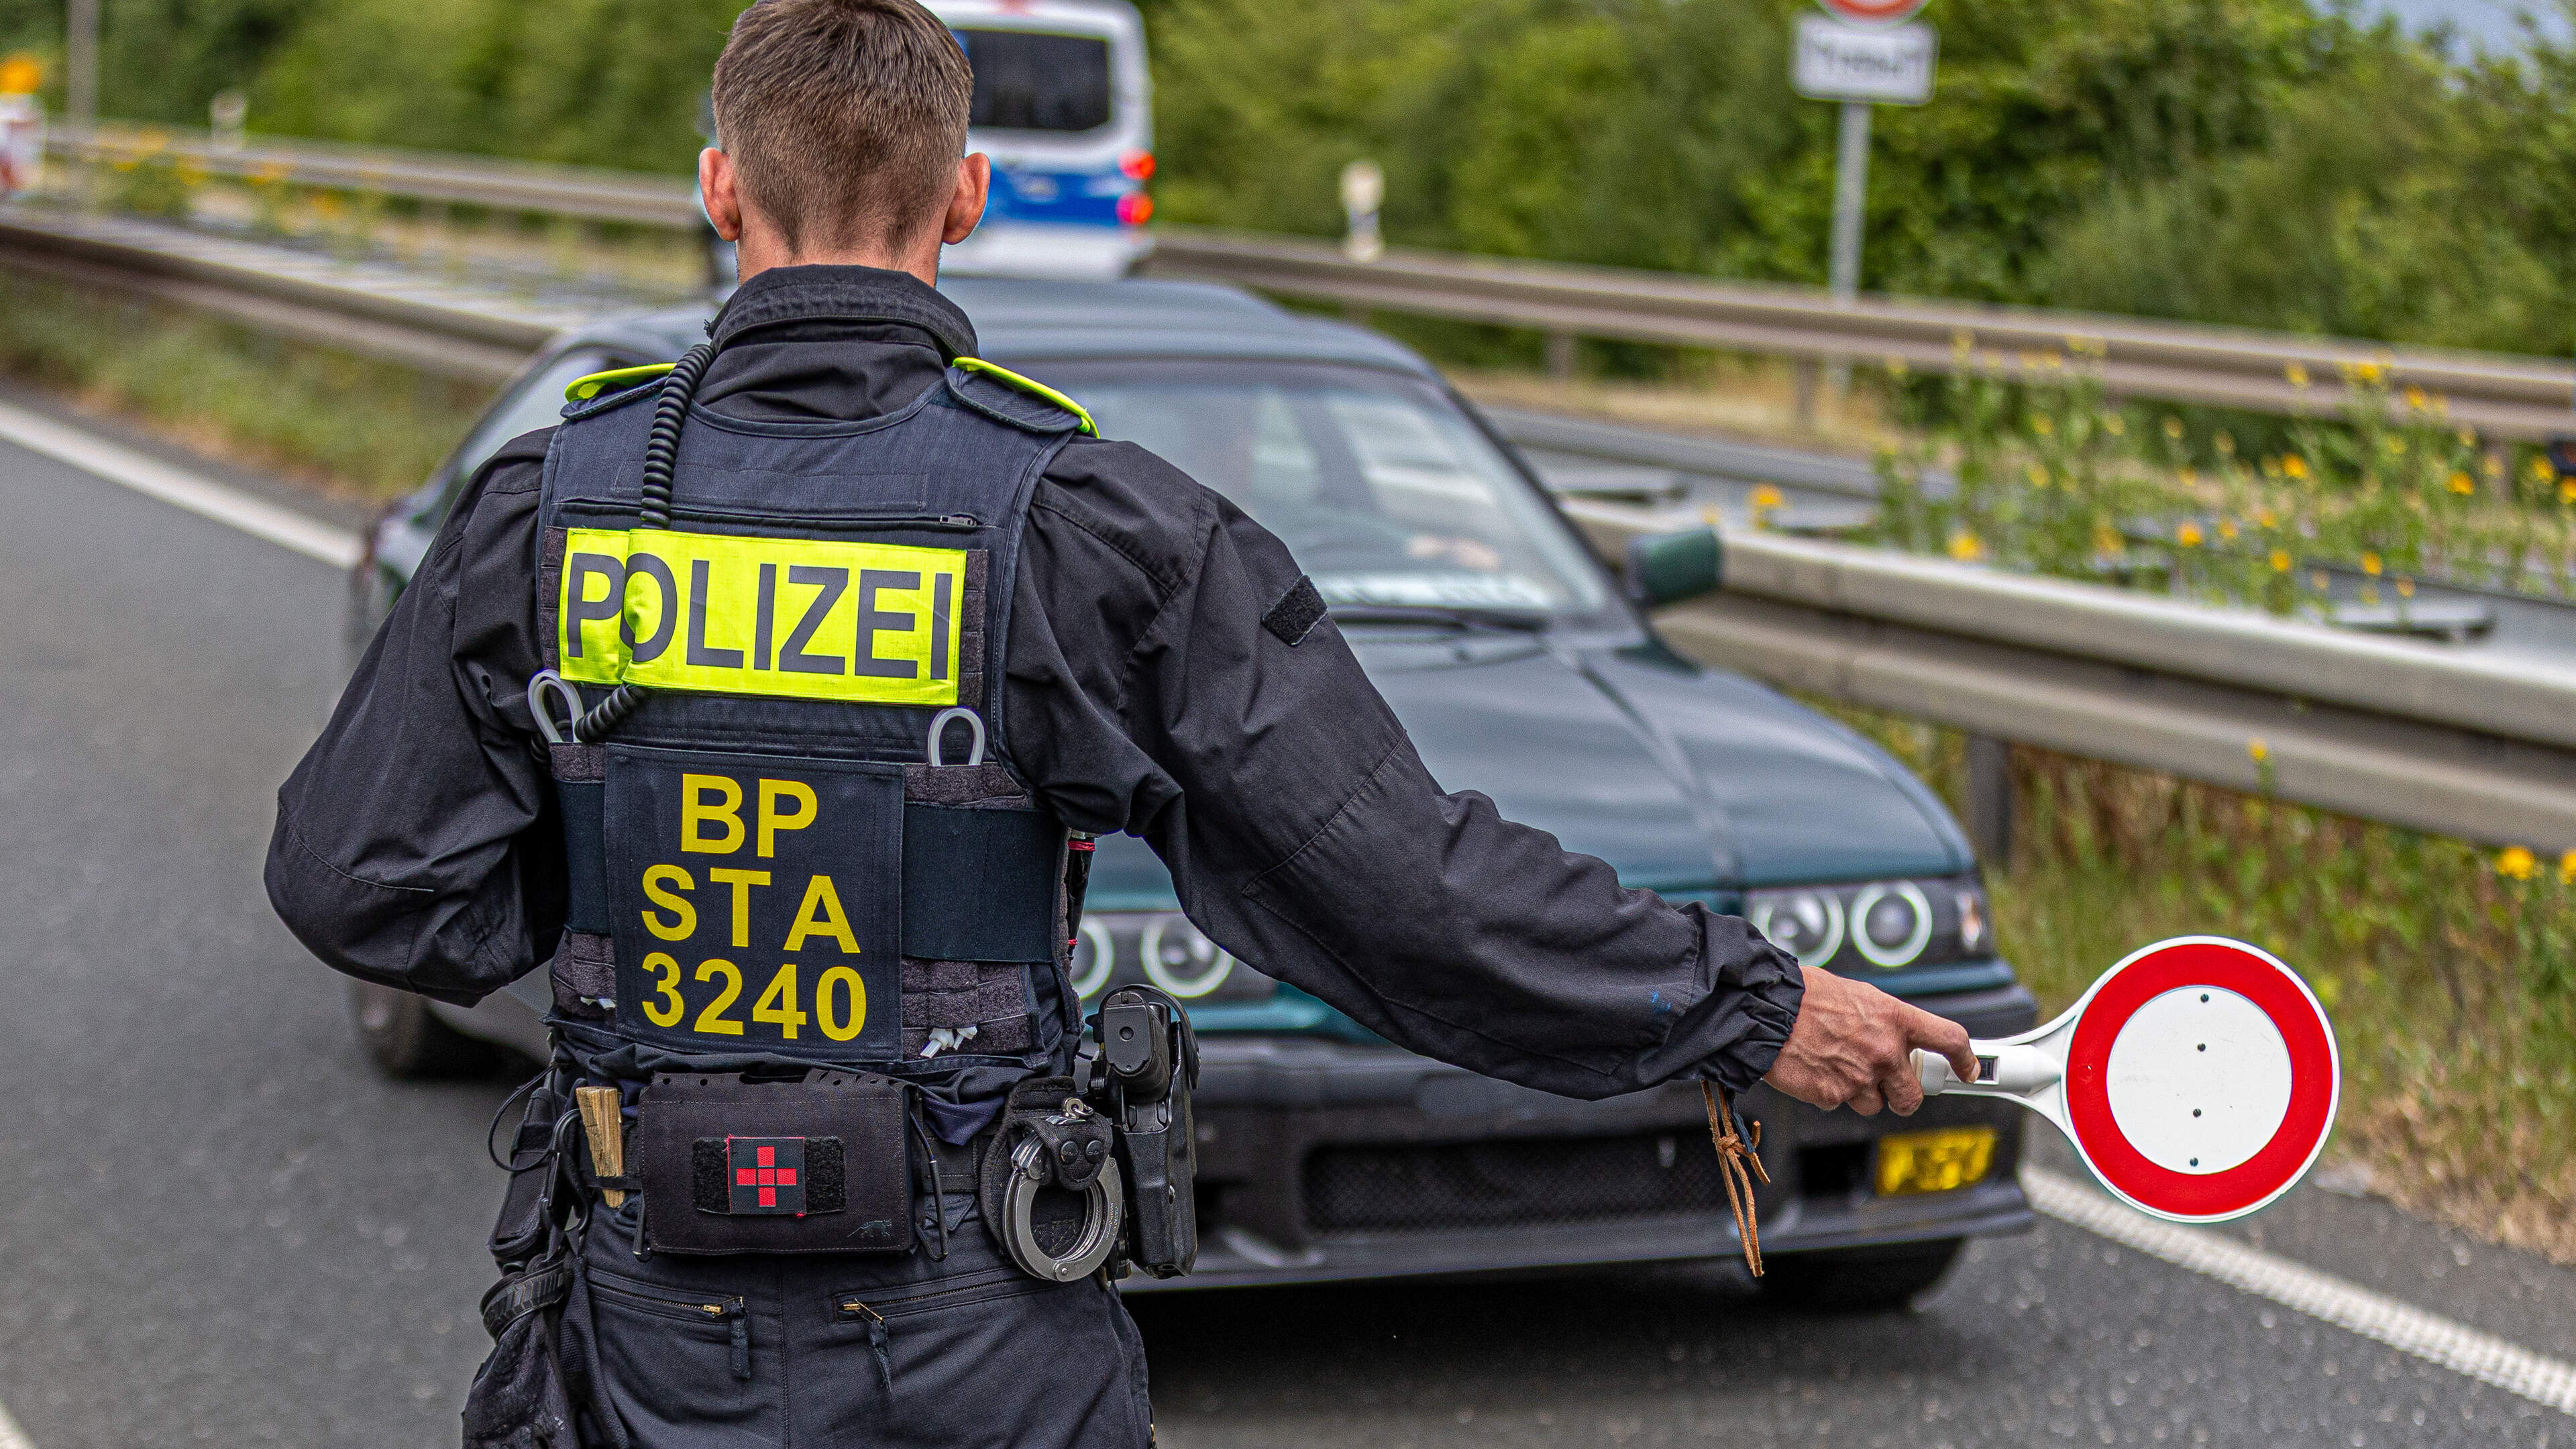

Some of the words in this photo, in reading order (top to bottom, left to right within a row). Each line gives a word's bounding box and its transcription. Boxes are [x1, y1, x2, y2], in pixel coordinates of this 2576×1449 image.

[566, 552, 953, 680] POLIZEI
[681, 773, 818, 858] BP
[641, 864, 861, 953] STA
[641, 952, 867, 1041] 3240
